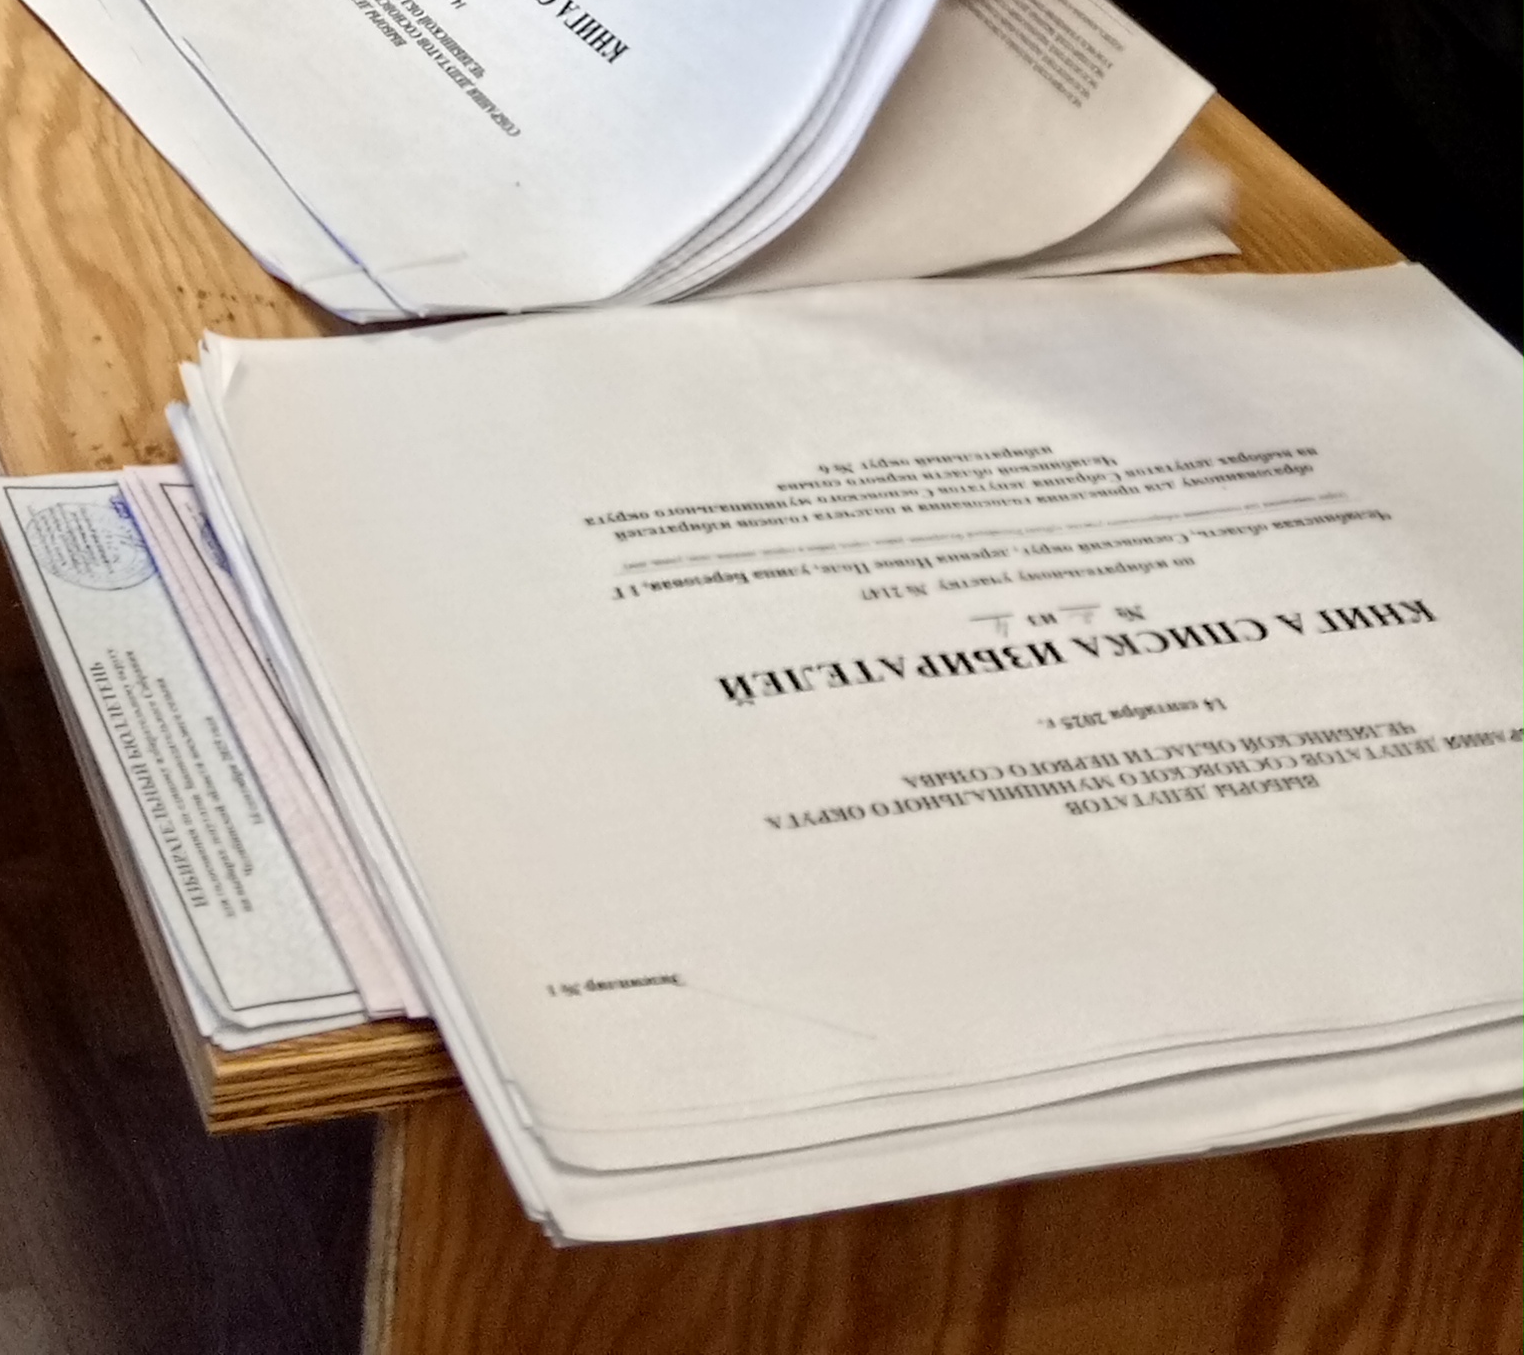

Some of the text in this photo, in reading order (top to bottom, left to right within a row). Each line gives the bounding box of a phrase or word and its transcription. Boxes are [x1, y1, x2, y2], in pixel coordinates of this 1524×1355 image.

[416, 35, 475, 92] ДЕПУТАТОВ
[1189, 520, 1268, 542] область,
[1271, 507, 1391, 533] Челябинская
[935, 544, 1010, 566] деревня
[1077, 529, 1188, 555] Сосновский
[753, 563, 811, 584] улица
[812, 558, 870, 579] Поле,
[873, 553, 933, 573] Новое
[641, 567, 749, 595] Березовая,
[859, 555, 1194, 602] по избирательному участку № 2147
[1026, 611, 1057, 627] из
[1114, 603, 1144, 623] №
[714, 598, 1437, 708] КНИГА СПИСКА ИЗБИРАТЕЛЕЙ
[1036, 695, 1227, 729] 14 сентября 2025 г.
[900, 718, 1416, 790] ЧЕЛЯБИНСКОЙ ОБЛАСТИ ПЕРВОГО СОЗЫВА
[87, 661, 210, 908] ИЗБИРАТЕЛЬНЫЙ БЮЛЛЕТЕНЬ
[763, 727, 1524, 831] РАНИЯ ДЕПУТАТОВ СОСНОВСКОГО МУНИЦИПАЛЬНОГО ОКРУГА
[1064, 772, 1319, 815] ВЫБОРЫ ДЕПУТАТОВ
